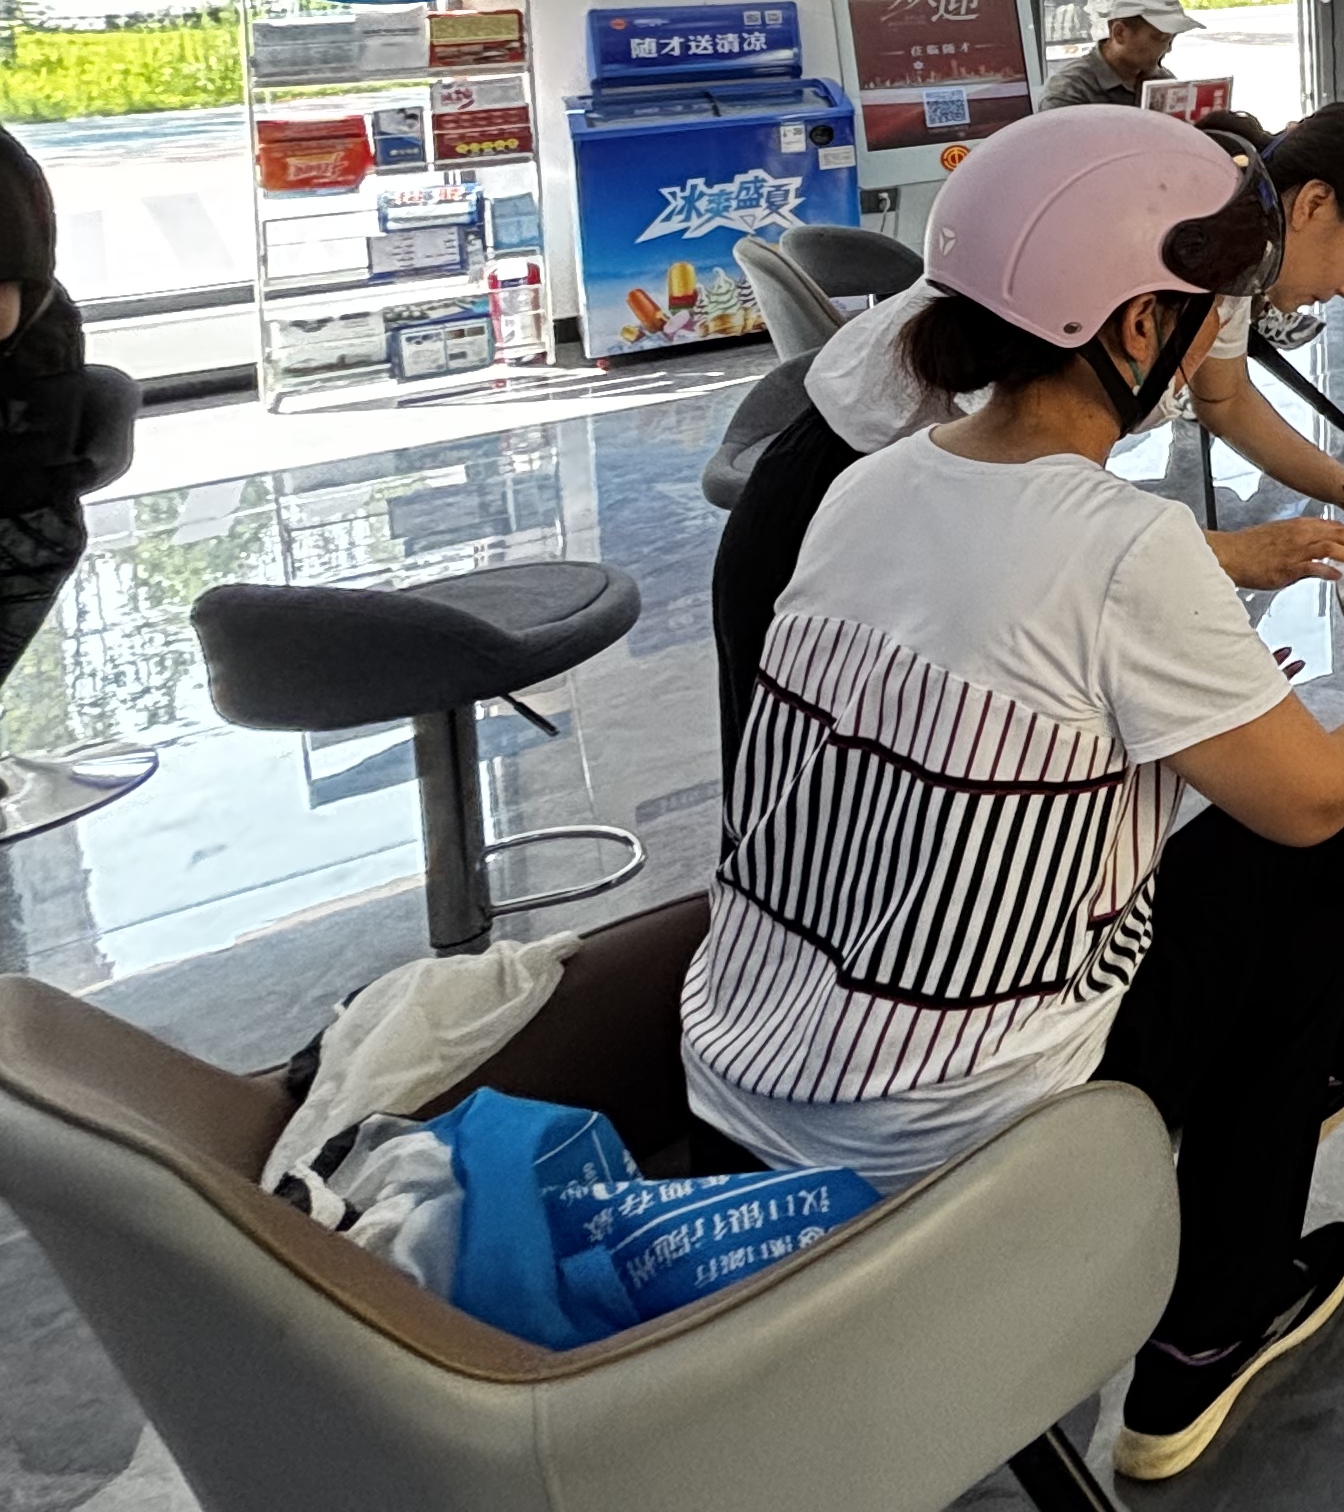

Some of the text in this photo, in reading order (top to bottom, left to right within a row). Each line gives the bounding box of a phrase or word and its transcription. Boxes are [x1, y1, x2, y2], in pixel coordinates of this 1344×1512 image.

[629, 32, 768, 59] 随才送清凉
[664, 174, 793, 221] 冰爽盛夏
